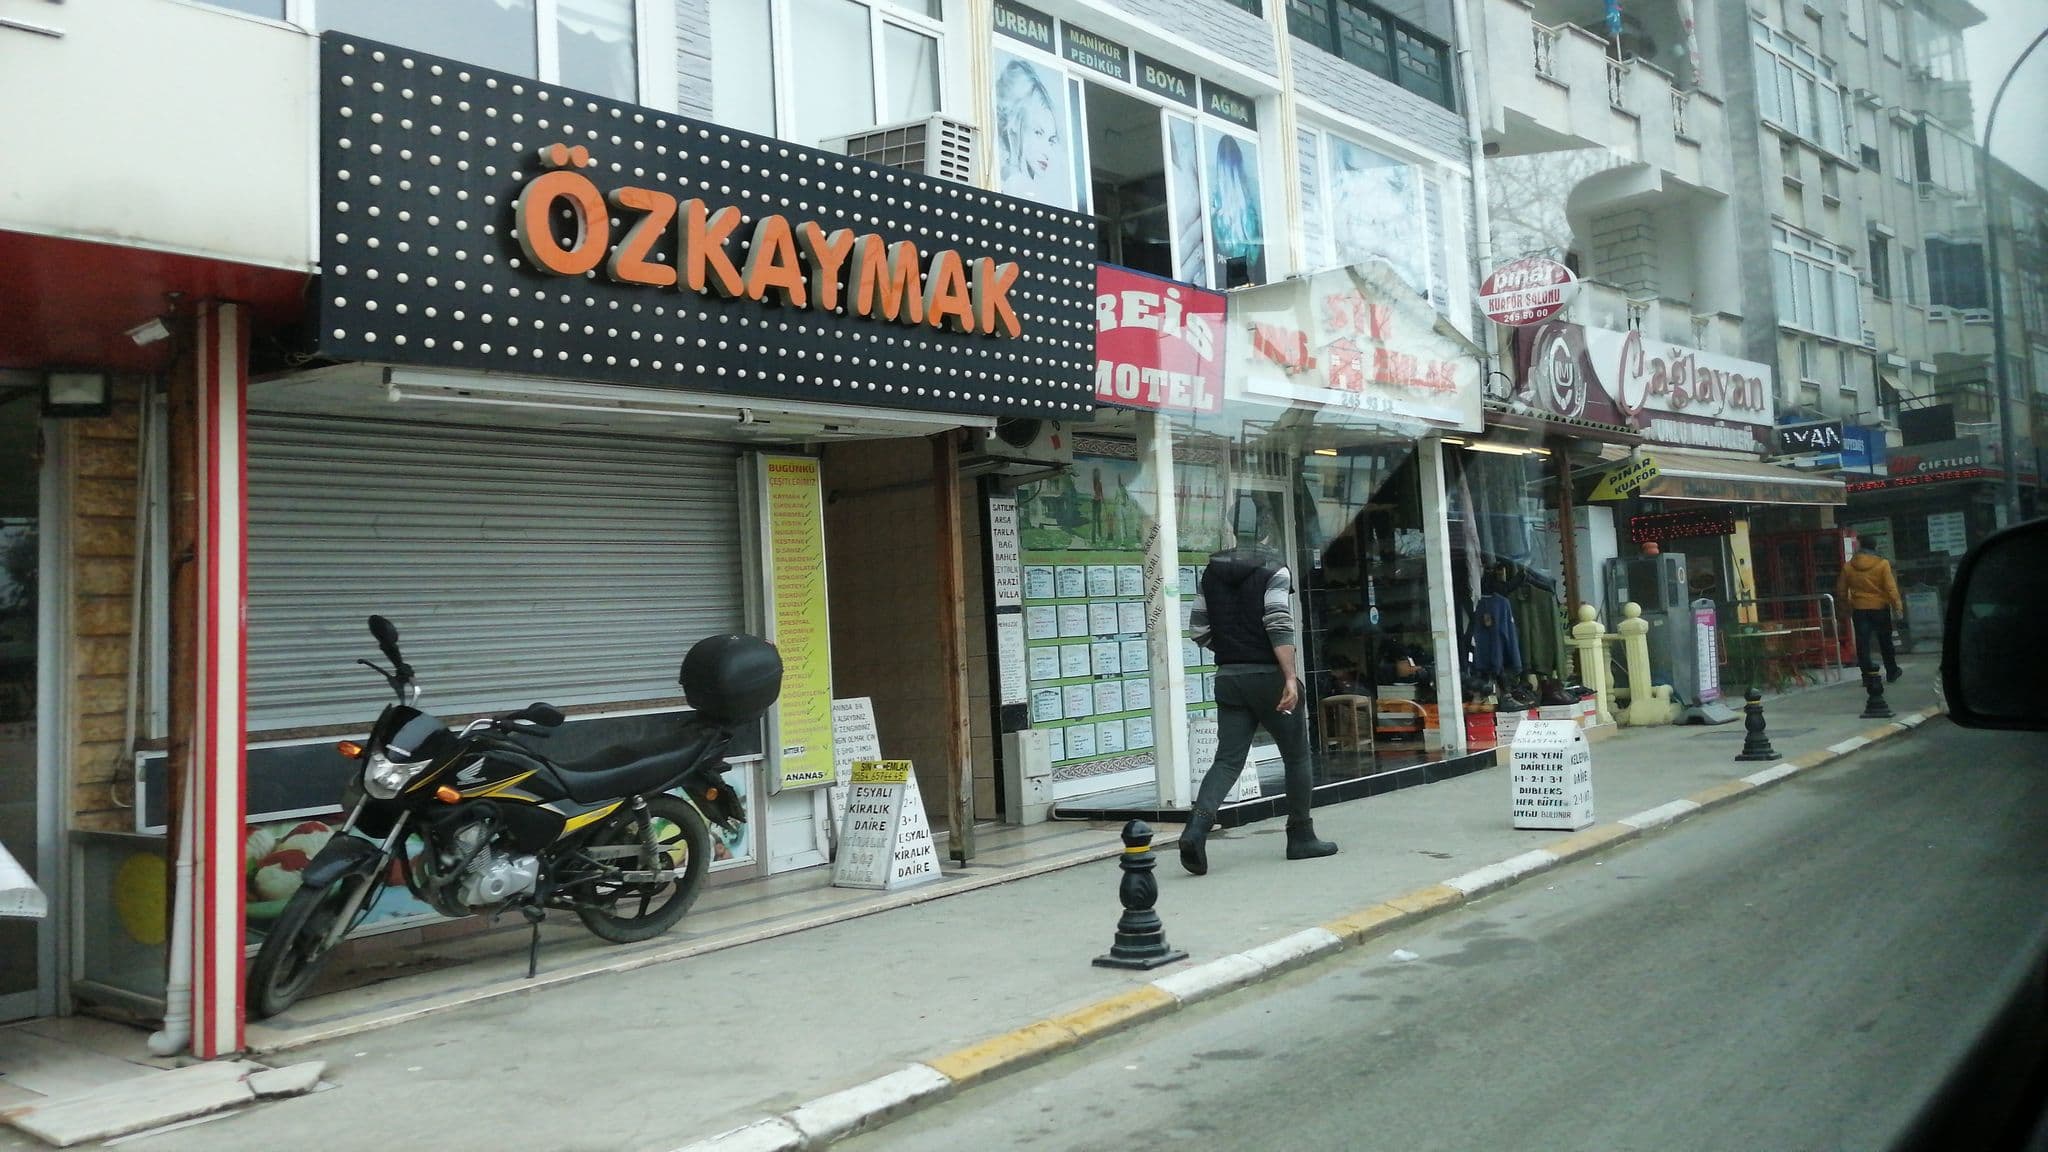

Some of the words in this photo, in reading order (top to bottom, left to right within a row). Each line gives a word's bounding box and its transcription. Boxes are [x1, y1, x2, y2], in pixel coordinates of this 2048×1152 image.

[1145, 65, 1187, 98] BOYA
[516, 142, 1022, 338] ÖZKAYMAK
[1096, 359, 1214, 411] MOTEL
[786, 771, 825, 781] ANANAS
[849, 800, 890, 814] KİRALIK
[855, 817, 887, 831] DAİRE
